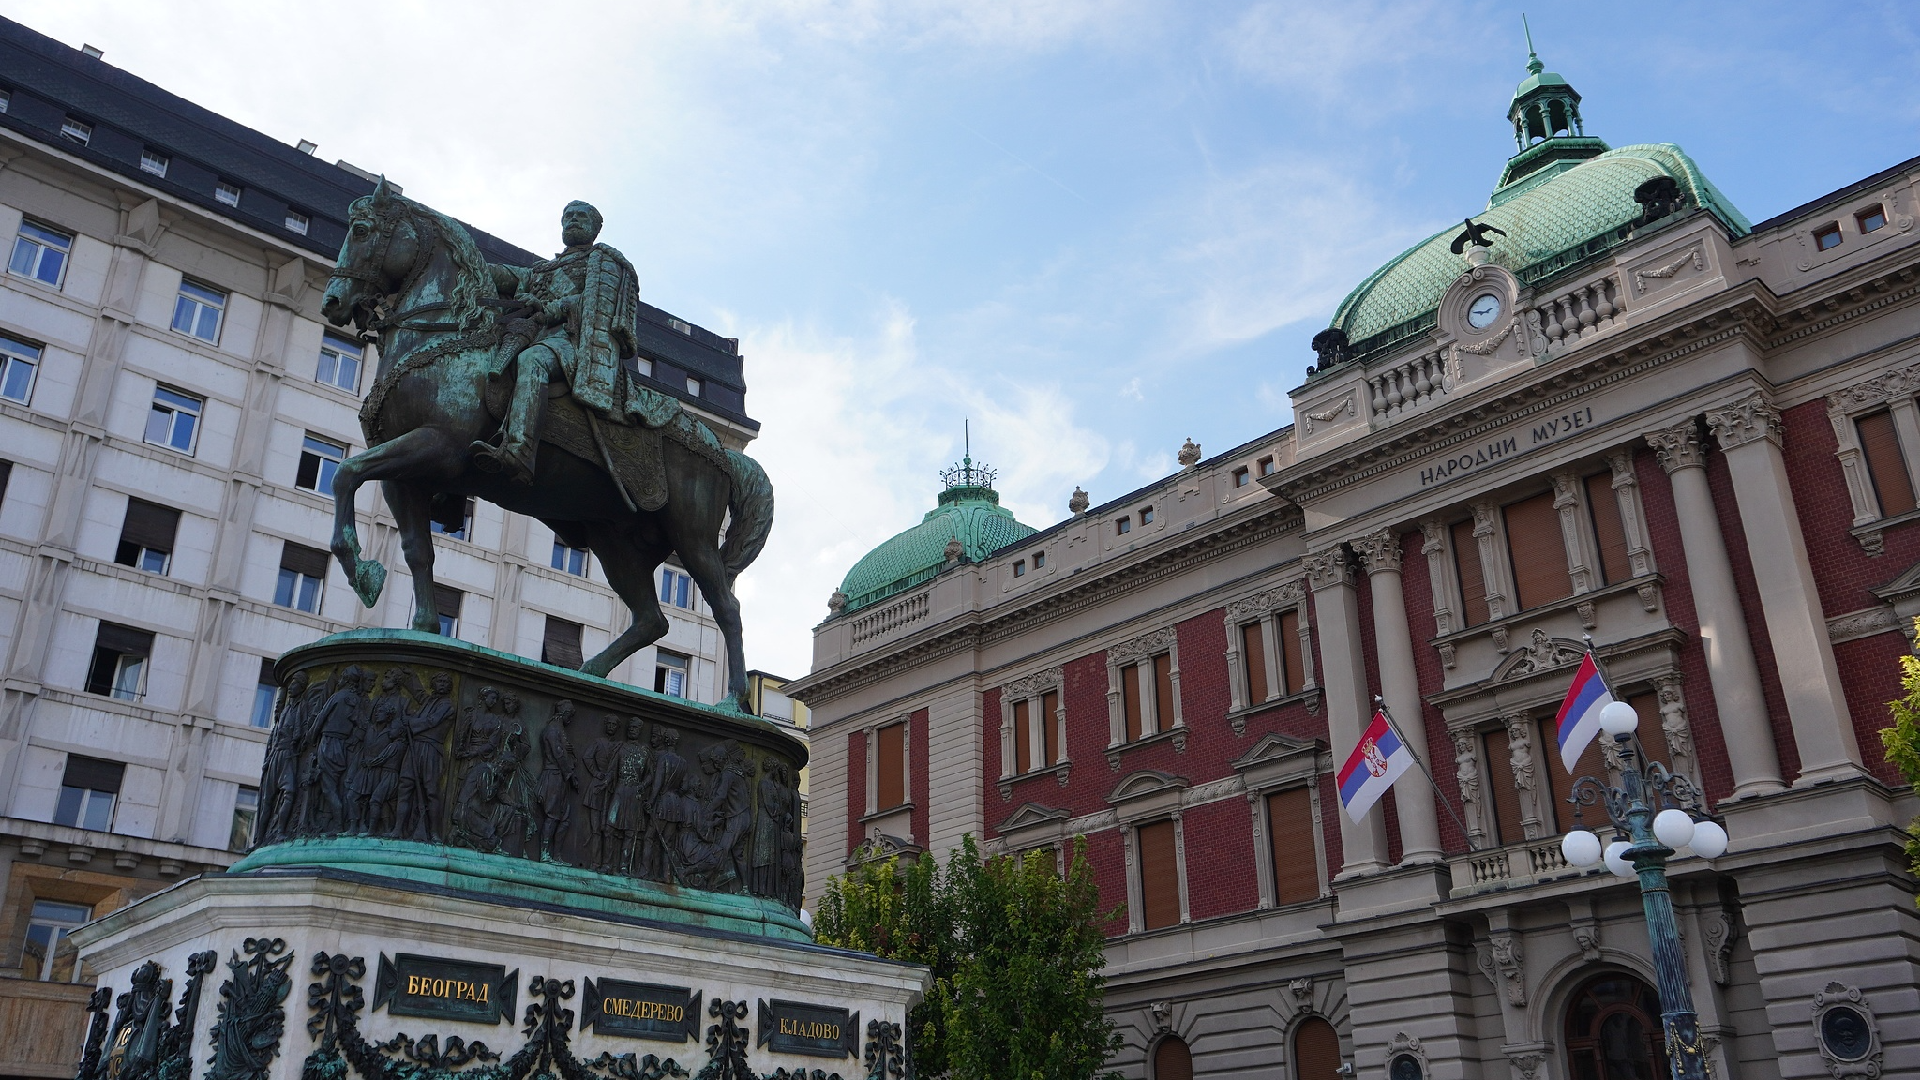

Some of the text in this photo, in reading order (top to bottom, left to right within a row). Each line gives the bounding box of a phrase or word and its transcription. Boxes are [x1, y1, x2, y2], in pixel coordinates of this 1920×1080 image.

[1420, 407, 1593, 485] НАРОДНИ МУЗЕЈ
[407, 975, 489, 1004] БЕОГРАД
[603, 997, 684, 1022] СМЕДЕРЕВО
[780, 1018, 840, 1040] КЛАДОВО
